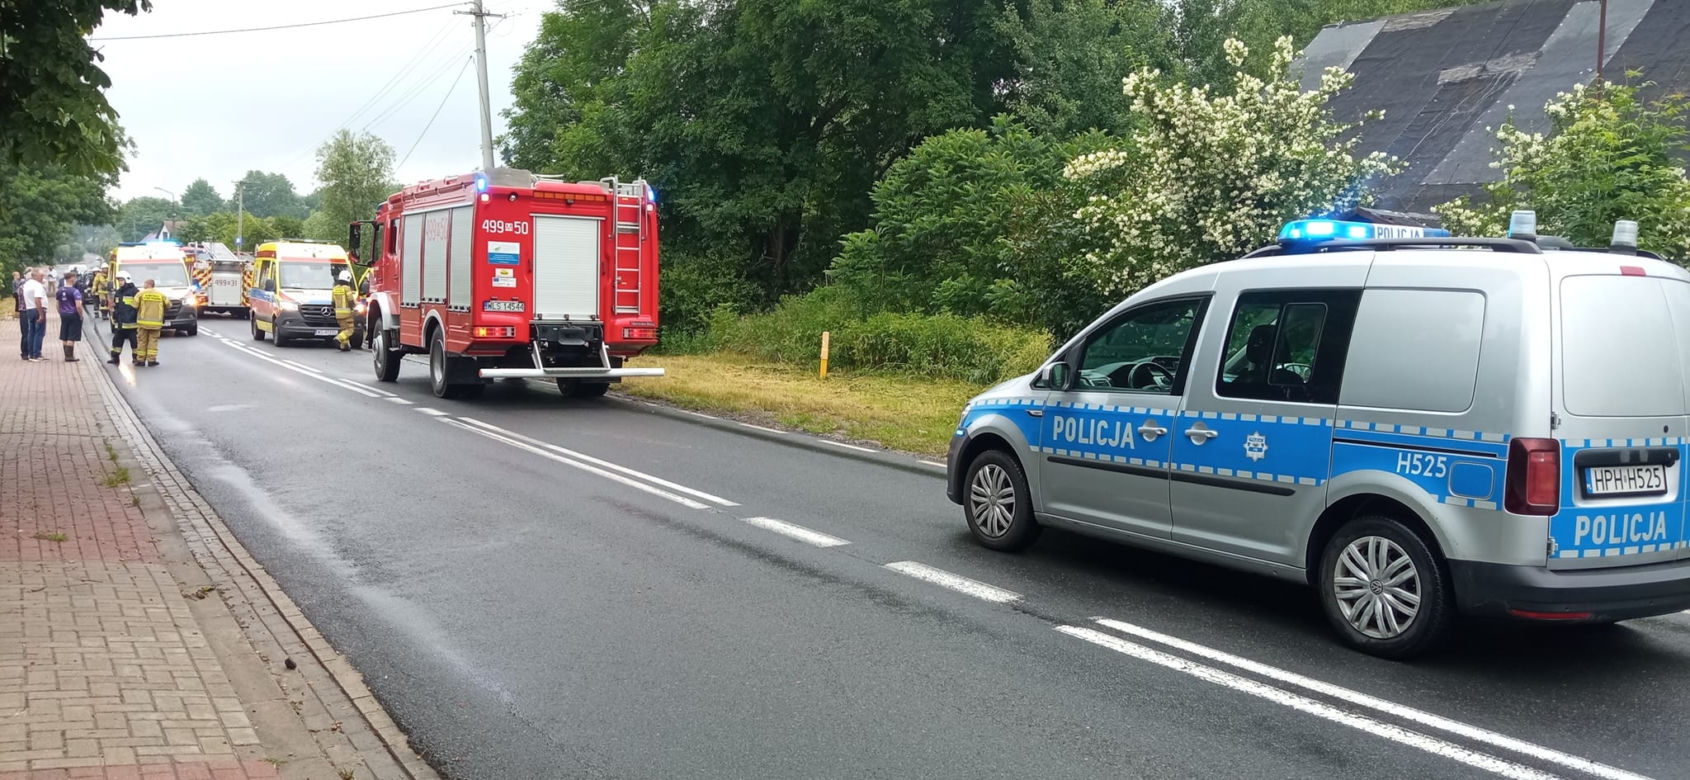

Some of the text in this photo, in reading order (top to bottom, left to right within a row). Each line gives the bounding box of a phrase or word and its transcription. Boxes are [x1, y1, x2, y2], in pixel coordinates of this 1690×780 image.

[1053, 415, 1135, 450] POLICJA
[1396, 452, 1447, 478] H525
[1594, 467, 1662, 491] HPH H525
[1574, 511, 1667, 546] POLICJA
